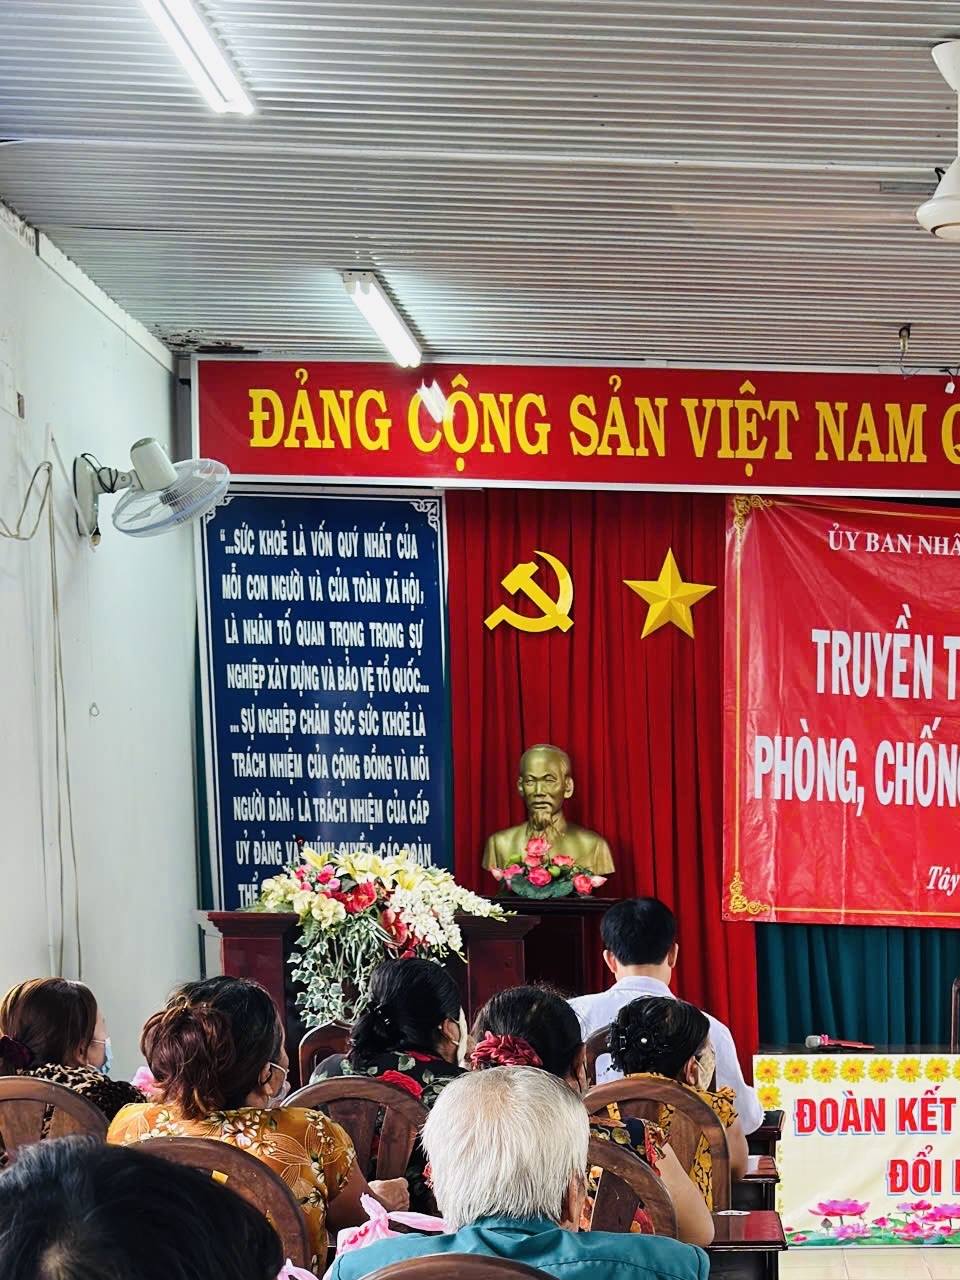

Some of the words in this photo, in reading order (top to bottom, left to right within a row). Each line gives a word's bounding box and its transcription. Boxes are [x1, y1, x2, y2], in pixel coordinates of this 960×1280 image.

[248, 368, 392, 451] ĐẢNG
[408, 373, 552, 472] CỘNG
[569, 374, 669, 457] SẢN
[680, 379, 800, 477] VIỆT
[815, 402, 928, 463] NAM
[292, 524, 307, 556] LÀ
[311, 520, 333, 557] VỐN
[337, 525, 359, 559] QUÝ
[363, 521, 392, 559] NHẤT
[397, 523, 419, 559] CỦA
[828, 523, 859, 551] ỦY
[865, 533, 913, 554] BAN
[246, 575, 269, 601] CON
[271, 568, 304, 601] NGƯỜI
[308, 569, 324, 602] VÀ
[328, 567, 350, 602] CỦA
[352, 571, 381, 603] TOÀN
[385, 570, 400, 604] XÃ
[224, 612, 239, 644] LÀ
[243, 613, 272, 645] NHÂN
[277, 608, 291, 645] TỐ
[296, 620, 325, 647] QUAN
[329, 621, 365, 654] TRỌNG
[369, 622, 404, 648] TRONG
[409, 618, 424, 656] SỰ
[811, 603, 934, 700] TRUYỀN
[227, 658, 266, 696] NGHIỆP
[267, 658, 289, 690] XÂY
[290, 660, 319, 697] DỰNG
[321, 658, 336, 691] VÀ
[337, 656, 358, 692] BẢO
[360, 660, 375, 698] VỆ
[376, 654, 391, 692] TỔ
[258, 702, 296, 740] NGHIỆP
[300, 702, 330, 735] CHĂM
[334, 702, 355, 735] SÓC
[358, 700, 379, 736] SỨC
[412, 702, 426, 737] LÀ
[232, 746, 267, 778] TRÁCH
[270, 747, 302, 785] NHIỆM
[307, 744, 329, 779] CỦA
[332, 747, 361, 787] CỘNG
[394, 748, 409, 781] VÀ
[754, 718, 865, 817] PHÒNG,
[233, 788, 265, 821] NGƯỜI
[298, 791, 312, 822] LÀ
[313, 790, 347, 823] TRÁCH
[350, 792, 383, 830] NHIỆM
[386, 788, 408, 824] CỦA
[409, 789, 430, 824] CẤP
[253, 829, 282, 865] ĐẢNG
[927, 865, 960, 896] Tây
[795, 1089, 886, 1135] ĐOÀN
[896, 1084, 957, 1135] KẾT
[887, 1144, 943, 1195] ĐỔI
